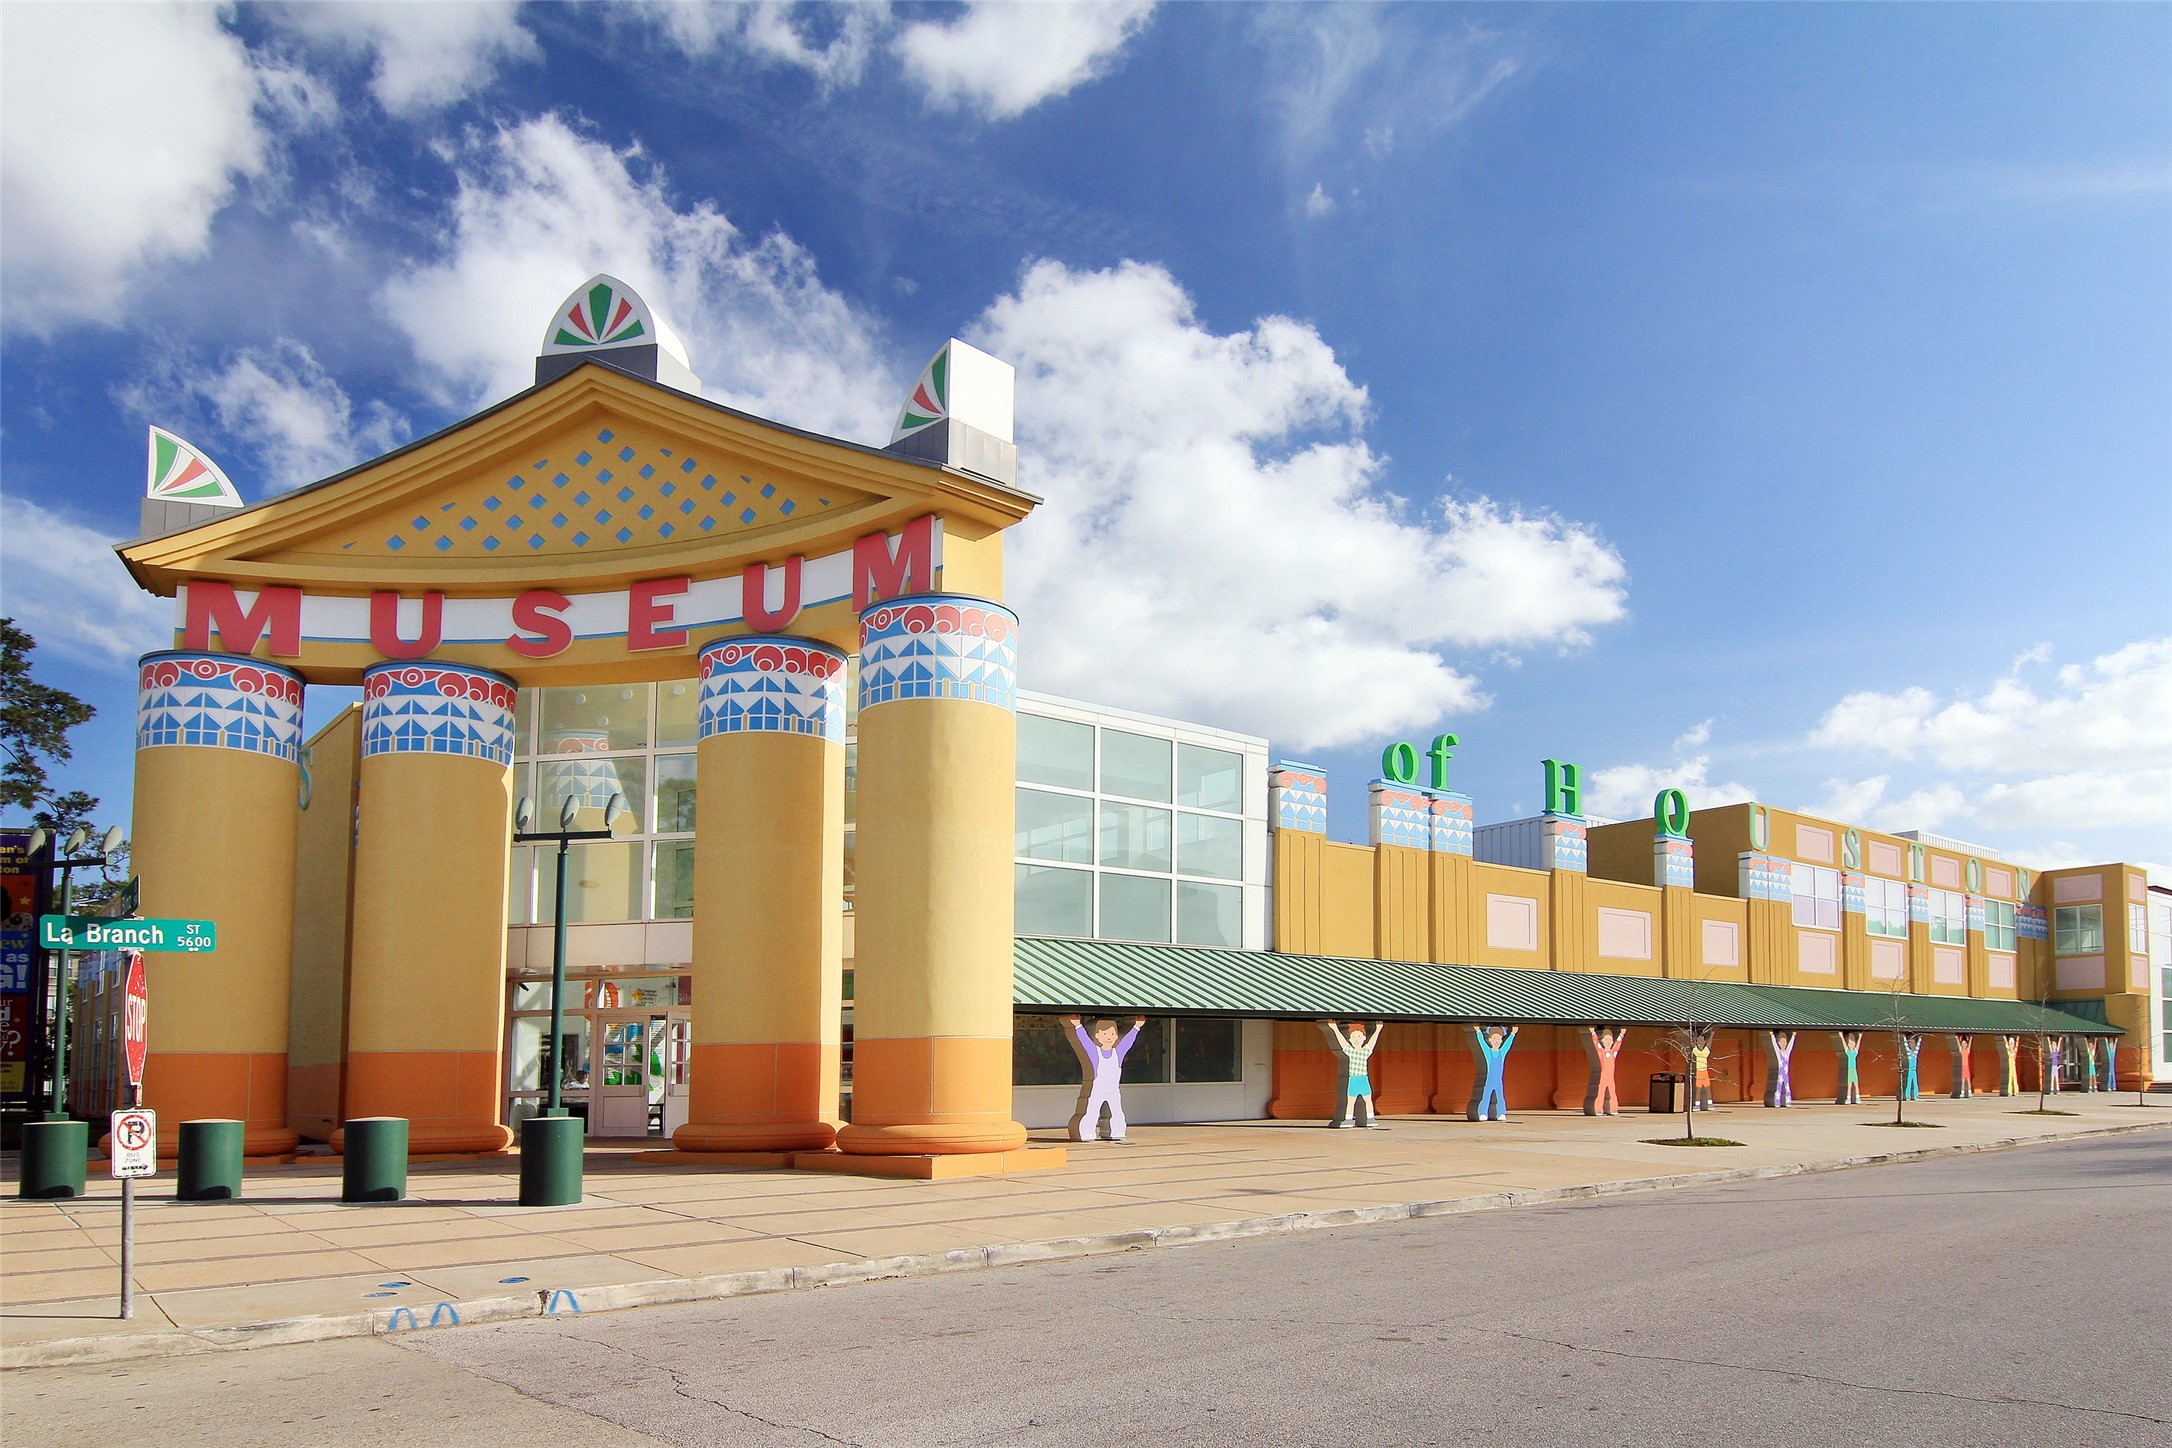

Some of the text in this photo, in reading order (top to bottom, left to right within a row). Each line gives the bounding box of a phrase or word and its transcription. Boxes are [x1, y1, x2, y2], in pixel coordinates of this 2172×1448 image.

[184, 514, 936, 659] MUSEUM
[1382, 732, 2031, 903] of HOUSTON
[46, 922, 200, 945] La Branch ST
[177, 936, 212, 947] 5600
[5, 953, 30, 963] as
[127, 993, 146, 1043] STOP
